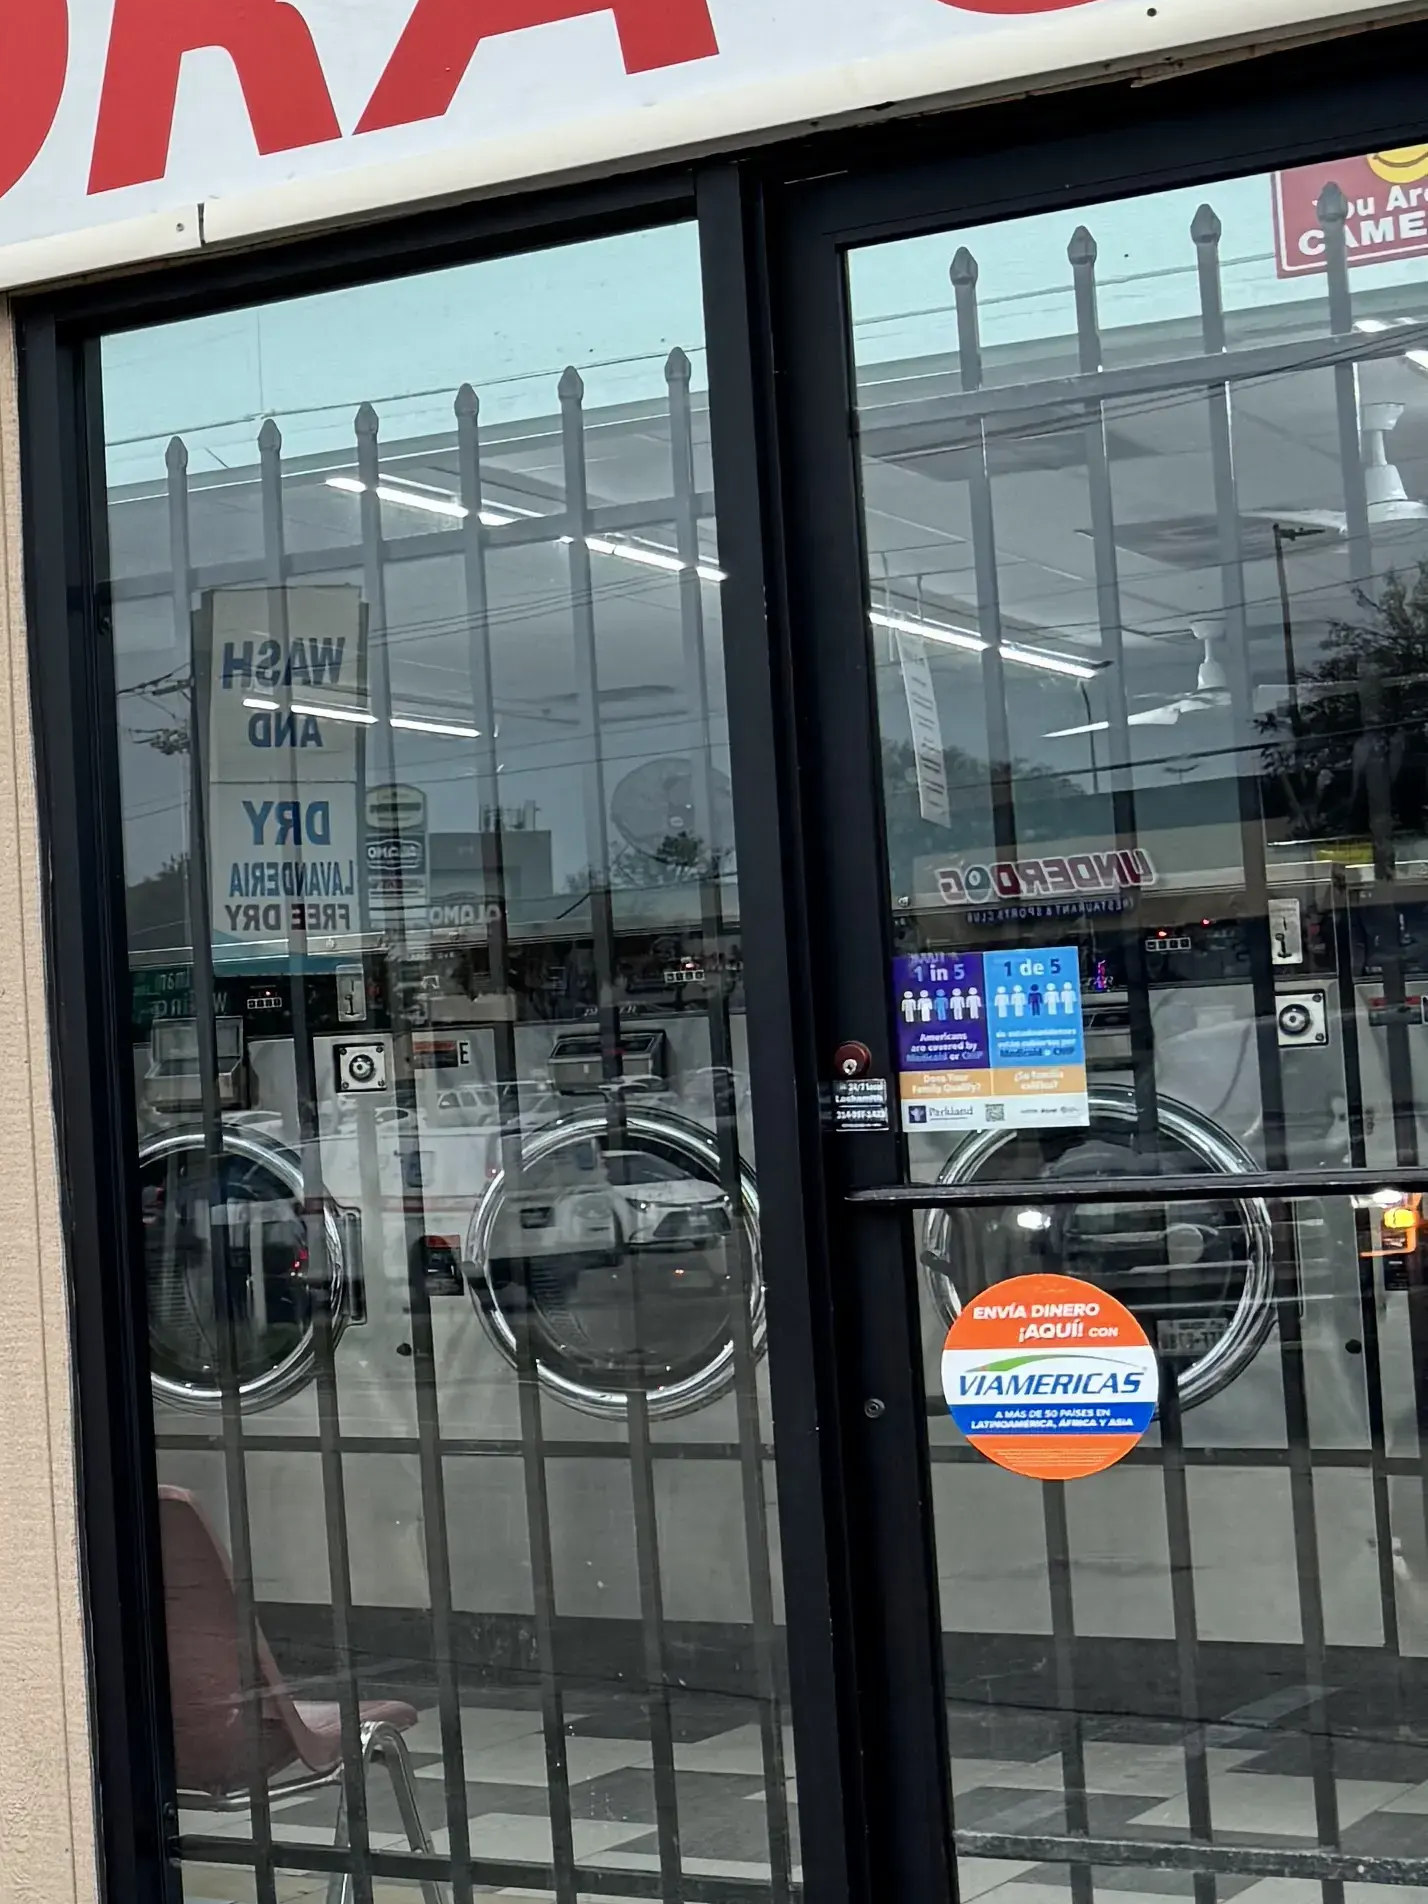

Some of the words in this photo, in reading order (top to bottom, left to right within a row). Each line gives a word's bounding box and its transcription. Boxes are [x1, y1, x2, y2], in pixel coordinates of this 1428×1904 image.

[1312, 196, 1375, 220] ou
[913, 965, 923, 982] 1
[930, 964, 949, 982] in
[954, 963, 965, 980] 5
[1004, 961, 1012, 977] 1
[1020, 959, 1044, 976] de
[1051, 958, 1061, 974] 5
[972, 1301, 1028, 1320] ENVÍA
[1031, 1302, 1101, 1318] DINERO
[1018, 1319, 1084, 1343] ¡AQUÍ!
[1088, 1327, 1119, 1338] CON
[959, 1372, 1145, 1396] VIAMERICAS
